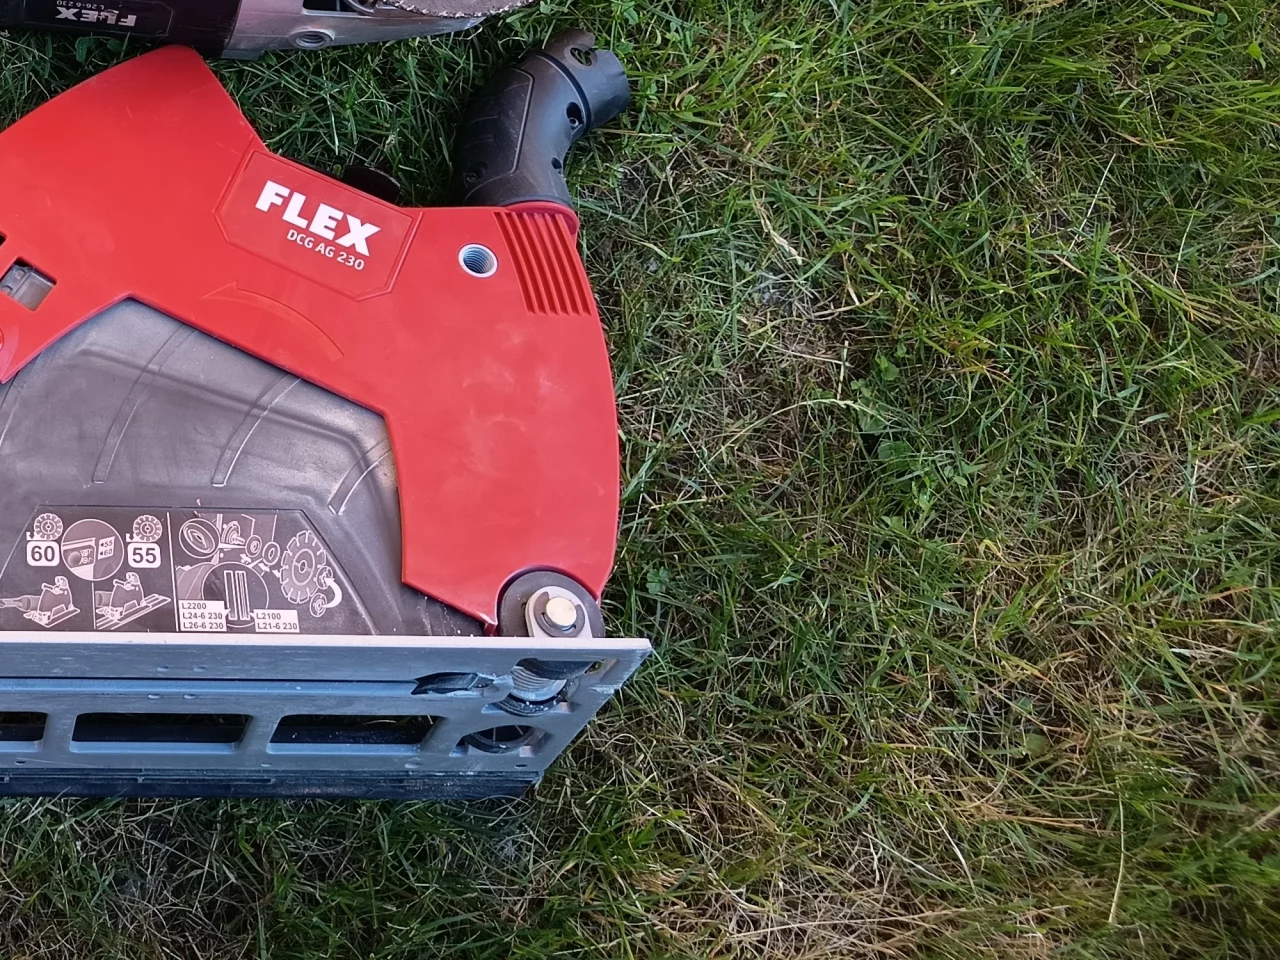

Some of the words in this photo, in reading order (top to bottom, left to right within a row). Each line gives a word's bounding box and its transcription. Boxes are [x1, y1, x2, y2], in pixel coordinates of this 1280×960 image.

[56, 0, 74, 7] 230
[55, 6, 137, 27] FLEX
[255, 179, 381, 257] FLEX
[286, 228, 314, 249] DCG
[315, 243, 335, 258] AG
[336, 251, 365, 271] 230
[30, 545, 55, 562] 60
[103, 548, 113, 556] 60
[132, 547, 157, 564] 55
[181, 602, 207, 610] L2200
[207, 612, 223, 620] 230
[256, 612, 281, 620] L2100
[209, 622, 224, 630] 230
[257, 622, 280, 630] L21-6
[283, 622, 298, 630] 230
